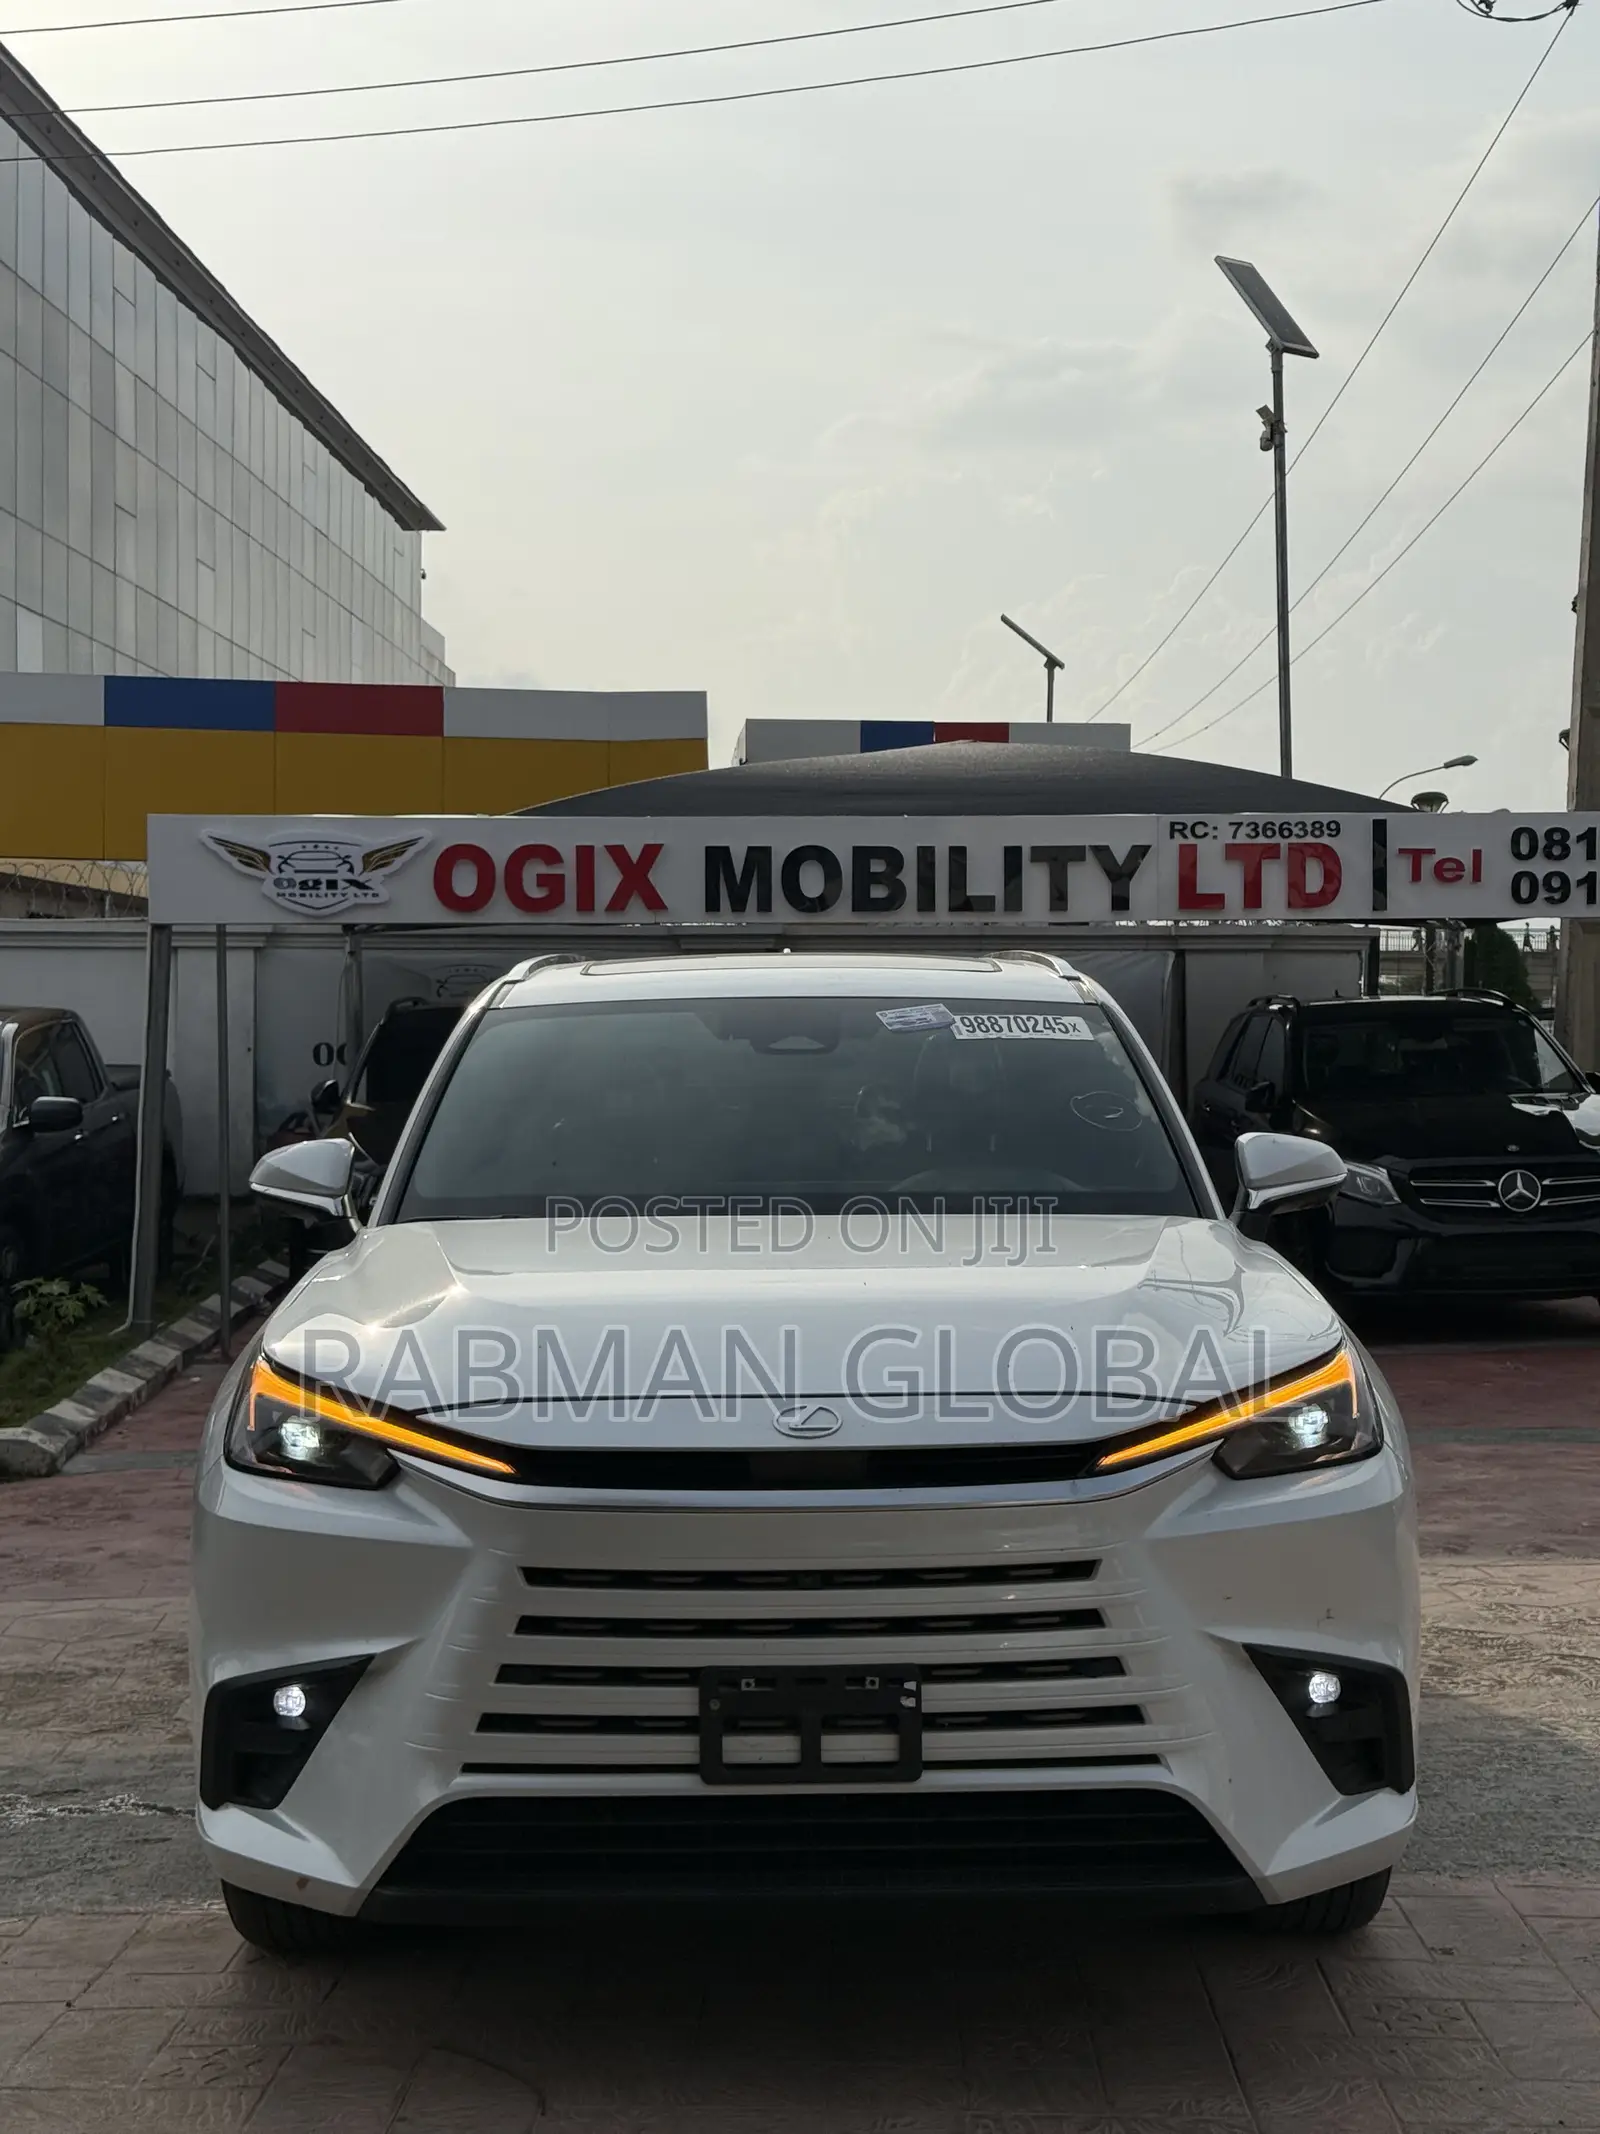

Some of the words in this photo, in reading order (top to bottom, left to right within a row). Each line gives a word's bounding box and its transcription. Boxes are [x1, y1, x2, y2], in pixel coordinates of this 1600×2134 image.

[1168, 820, 1219, 840] RC:
[1228, 819, 1342, 840] 7366389
[1510, 826, 1598, 861] 081
[433, 843, 668, 913] OGIX
[705, 843, 1153, 912] MOBILITY
[1178, 842, 1343, 911] LTD
[1398, 848, 1483, 884] Tel
[1510, 870, 1598, 905] 091
